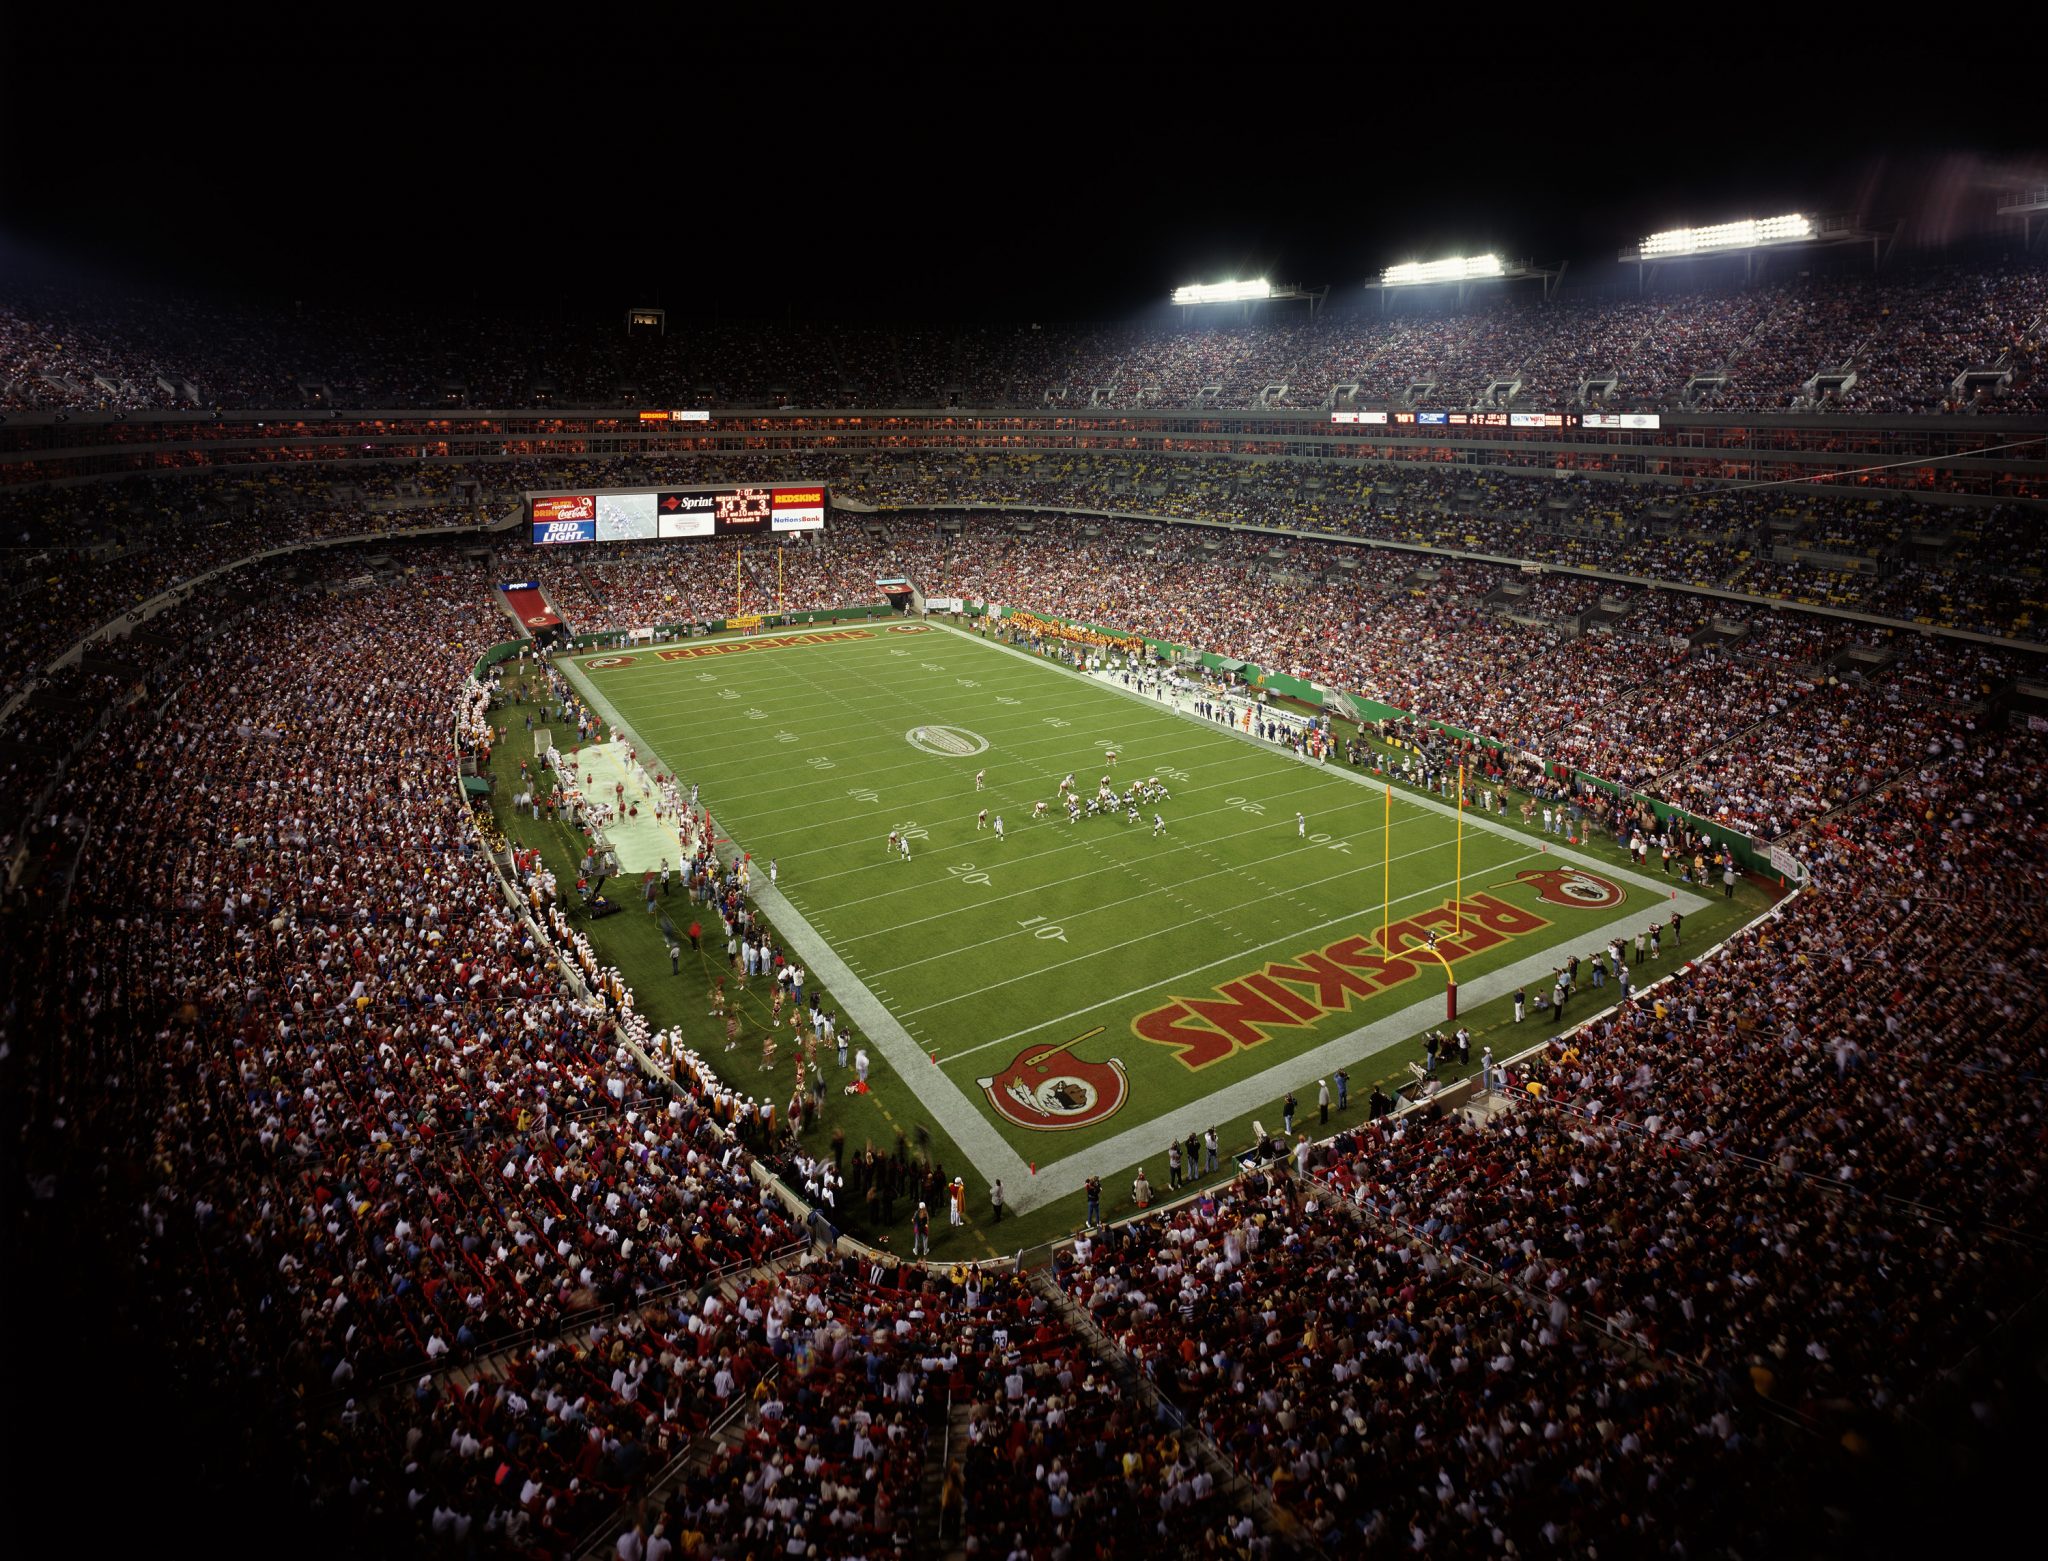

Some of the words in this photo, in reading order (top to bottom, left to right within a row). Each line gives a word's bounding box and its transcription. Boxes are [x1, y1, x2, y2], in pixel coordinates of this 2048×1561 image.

[681, 497, 714, 510] Sprint
[775, 493, 820, 503] REDSKINS
[721, 500, 734, 511] 14
[759, 500, 766, 509] 3
[716, 510, 729, 518] 1ST
[549, 523, 579, 532] BUD
[543, 531, 584, 541] LIGHT
[655, 630, 879, 661] REDSKINS
[807, 757, 836, 769] 50
[1155, 766, 1190, 780] 30
[1225, 797, 1266, 812] 20
[893, 821, 928, 839] 30
[1309, 833, 1352, 850] 10
[946, 863, 990, 884] 20
[1017, 915, 1063, 940] 10
[1130, 891, 1555, 1073] REDSKINS
